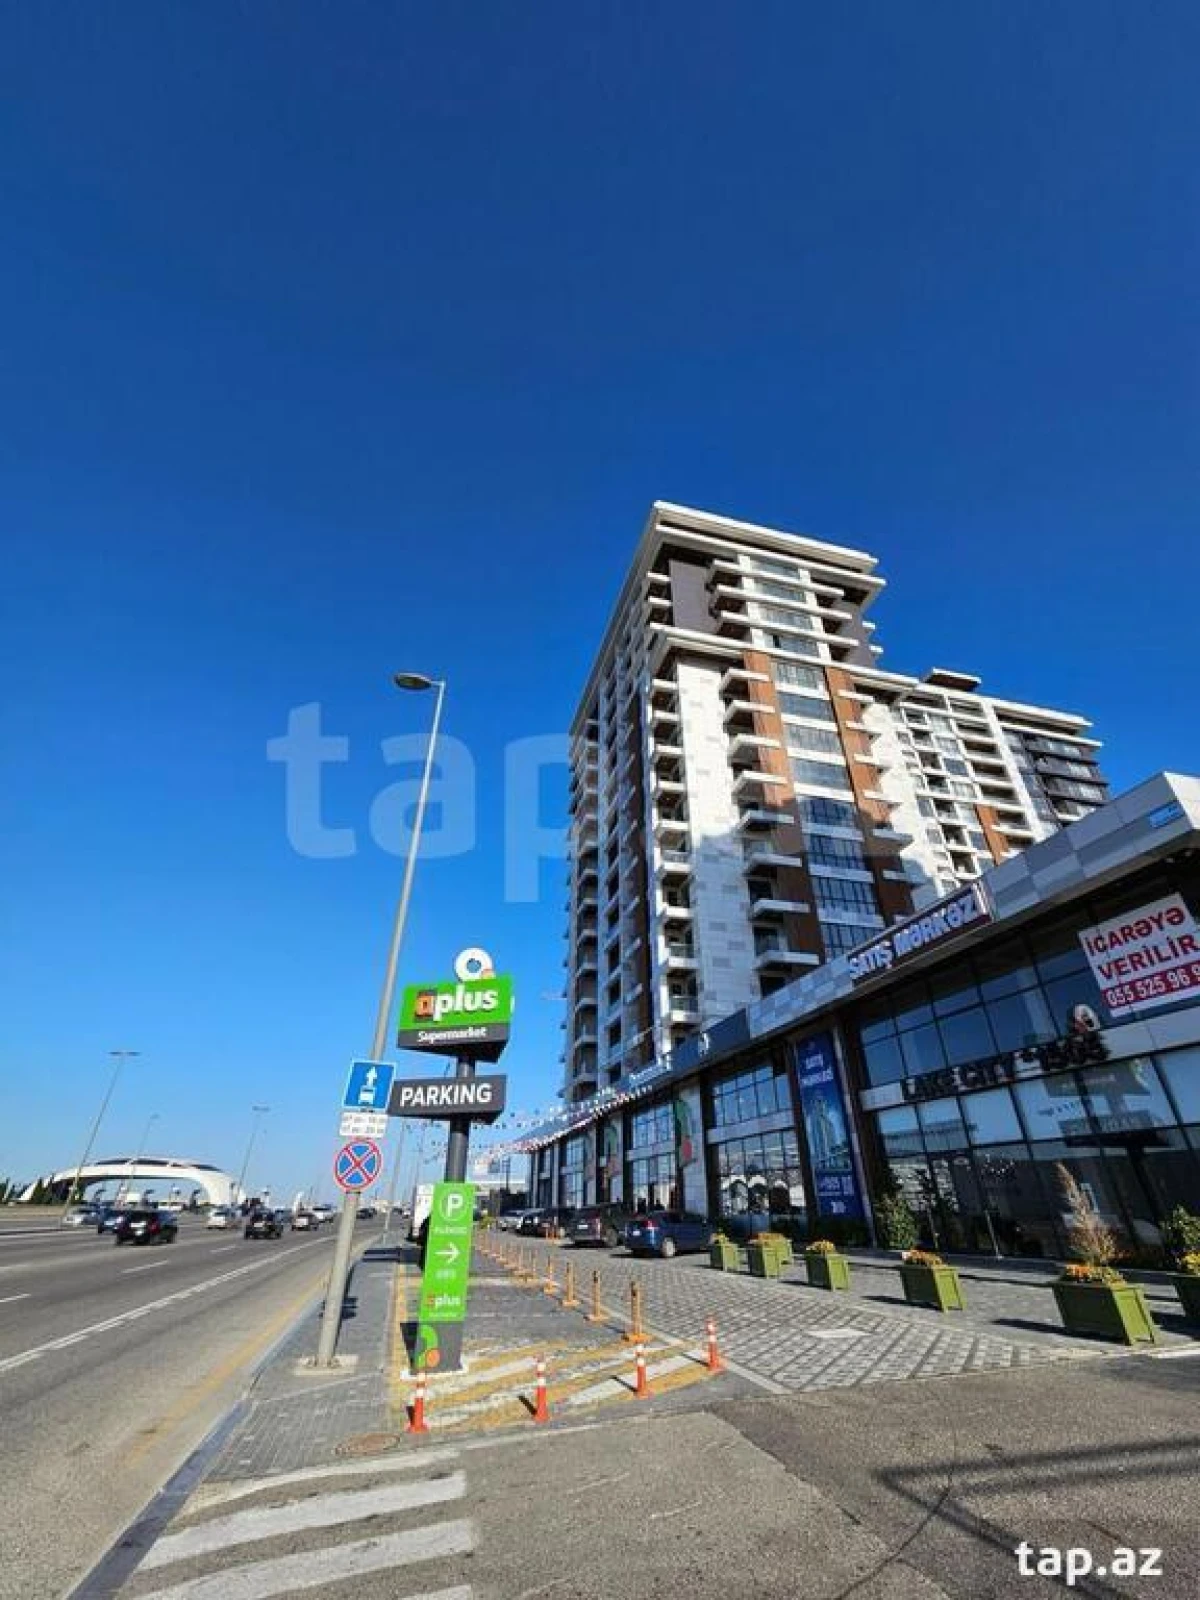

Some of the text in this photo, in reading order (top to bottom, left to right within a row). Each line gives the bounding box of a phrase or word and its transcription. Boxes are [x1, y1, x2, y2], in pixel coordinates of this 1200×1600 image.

[1106, 985, 1134, 1007] 055
[1135, 976, 1166, 999] 525
[1166, 967, 1191, 989] 96
[416, 984, 500, 1021] aplus
[417, 1026, 488, 1044] Supermarket
[399, 1083, 493, 1107] PARKING
